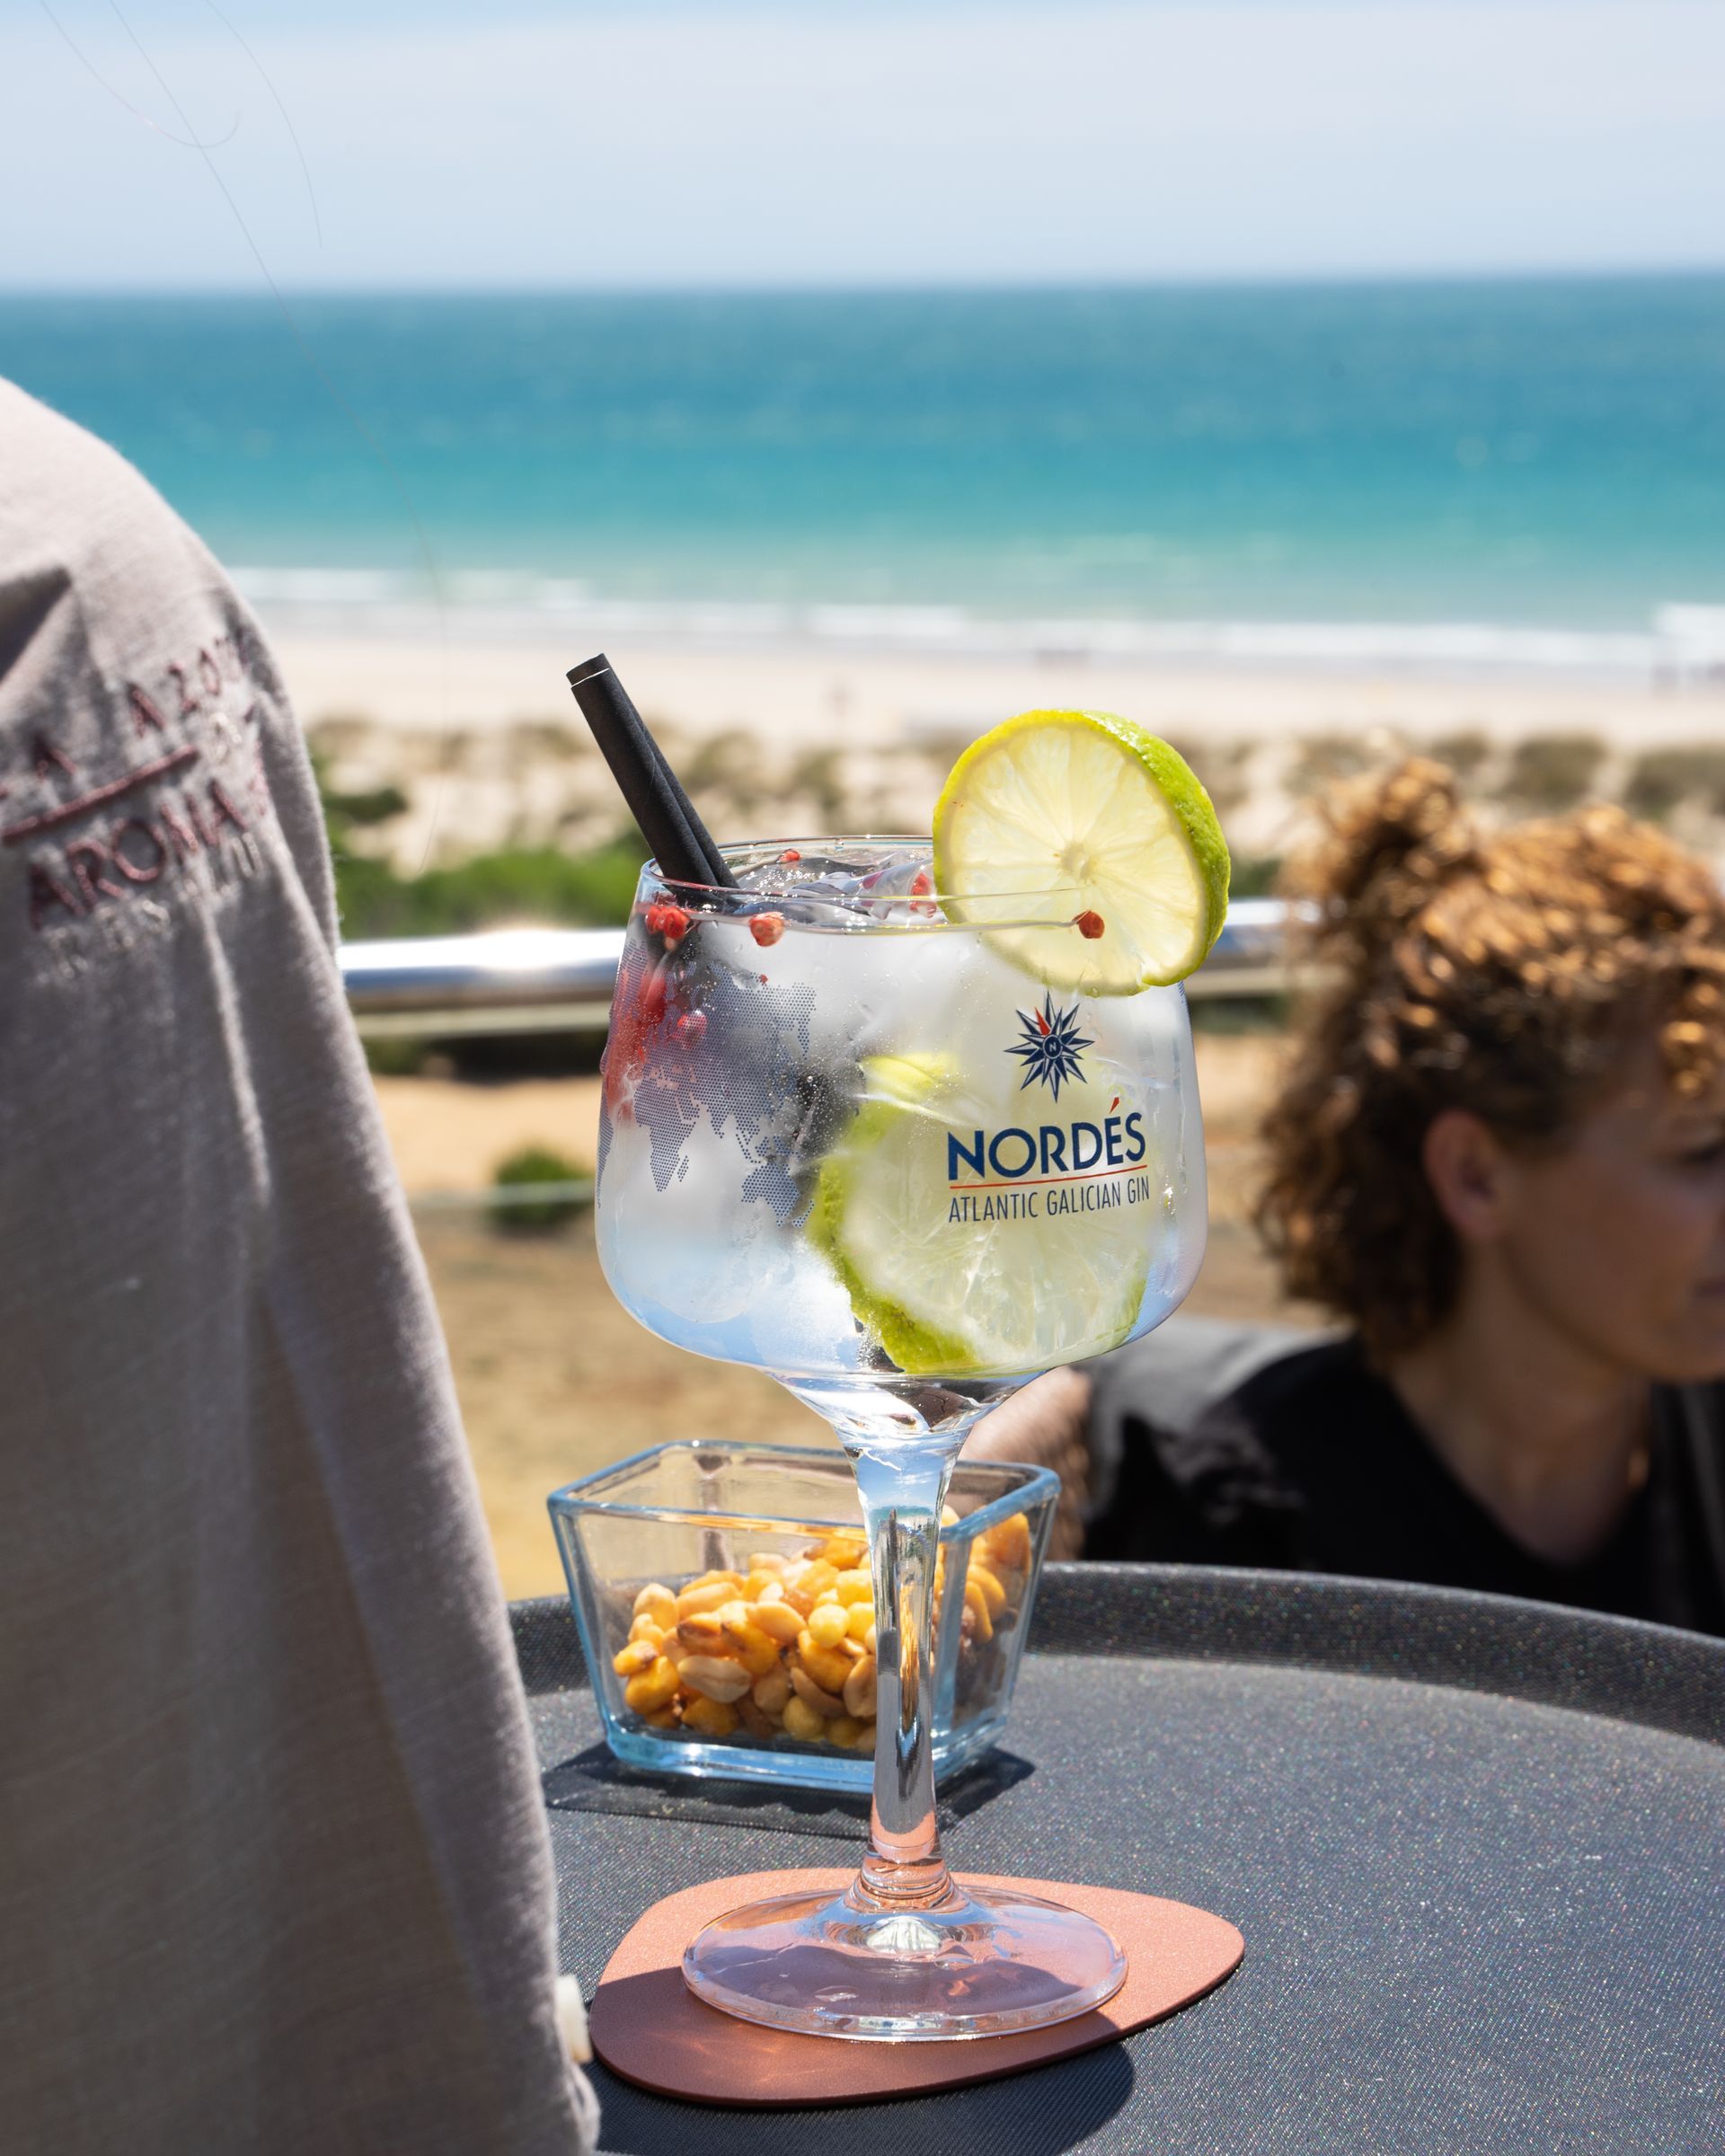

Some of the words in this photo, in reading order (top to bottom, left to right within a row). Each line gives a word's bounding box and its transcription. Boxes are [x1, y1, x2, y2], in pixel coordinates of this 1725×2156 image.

[948, 1097, 1146, 1181] NORDÉS
[949, 1192, 1039, 1223] ATLANTIC
[1047, 1180, 1121, 1216] GALICIAN
[1128, 1175, 1150, 1205] GIN
